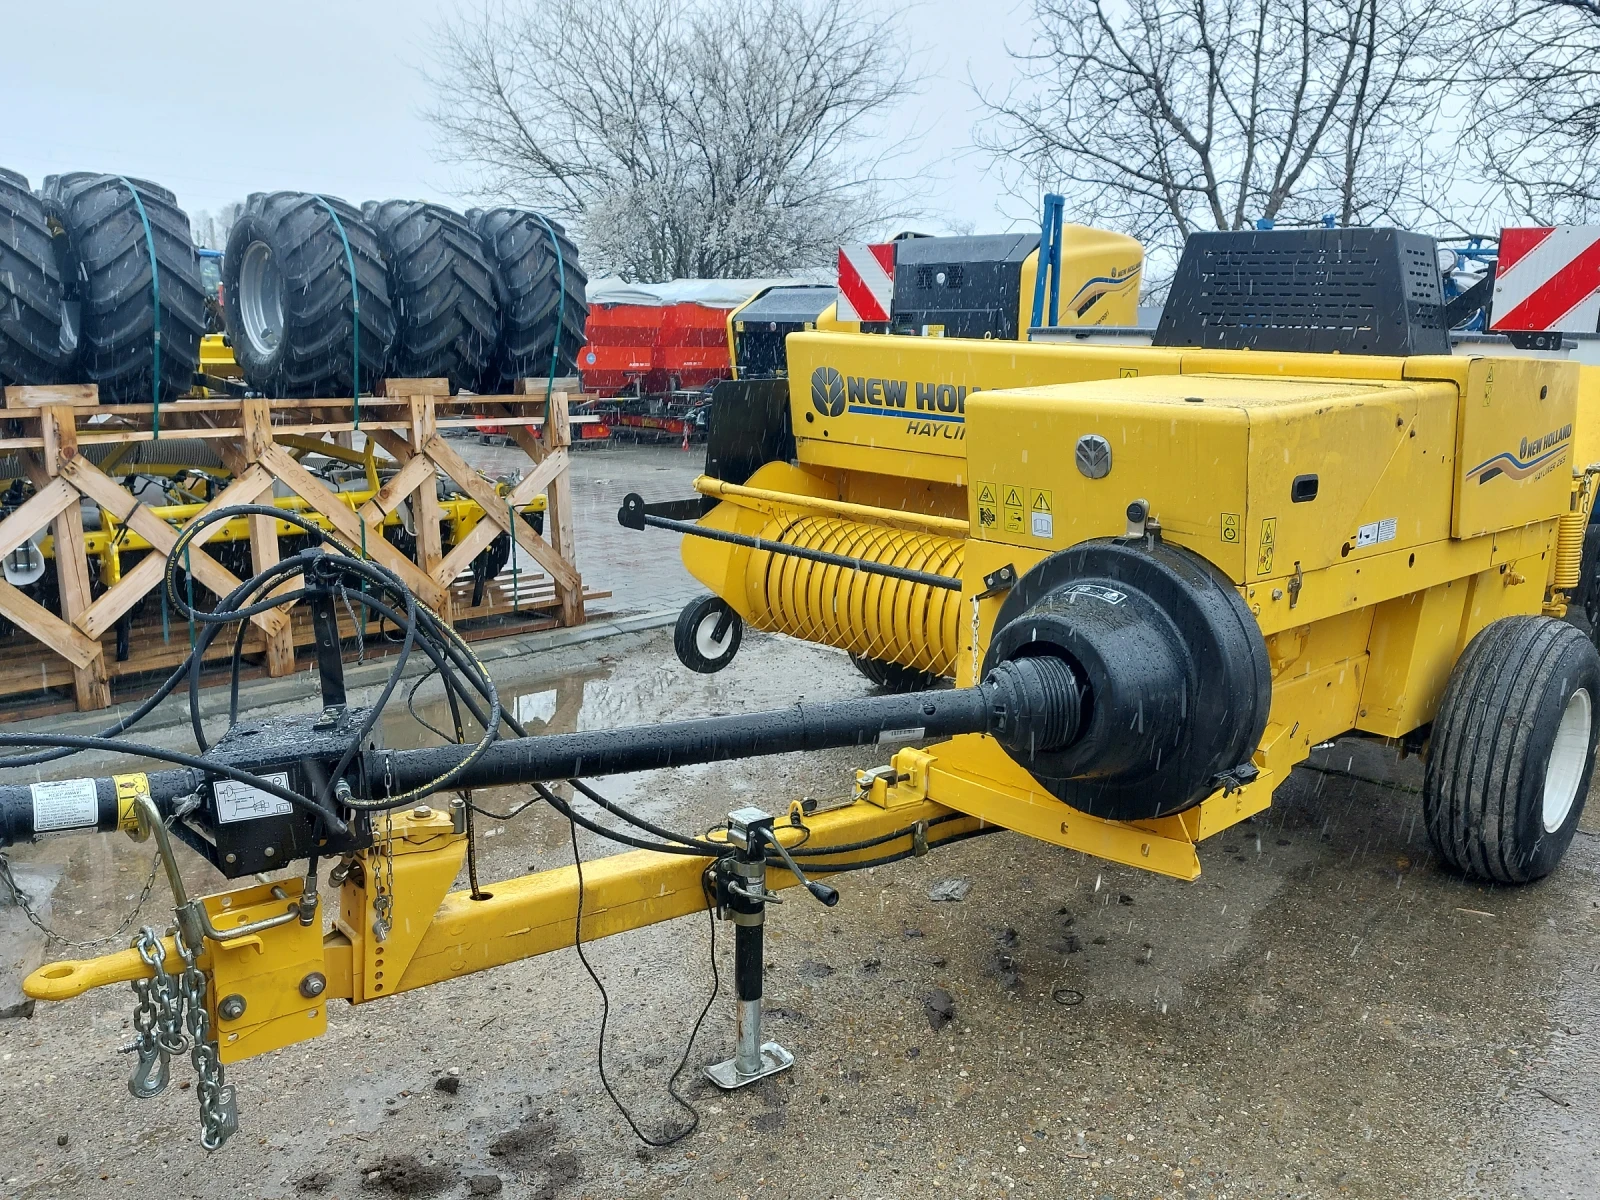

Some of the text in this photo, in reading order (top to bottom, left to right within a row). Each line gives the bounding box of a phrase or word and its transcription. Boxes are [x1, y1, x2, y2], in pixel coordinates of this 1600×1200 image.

[847, 376, 907, 408] NEW
[1526, 424, 1572, 459] NEW HOLLAND
